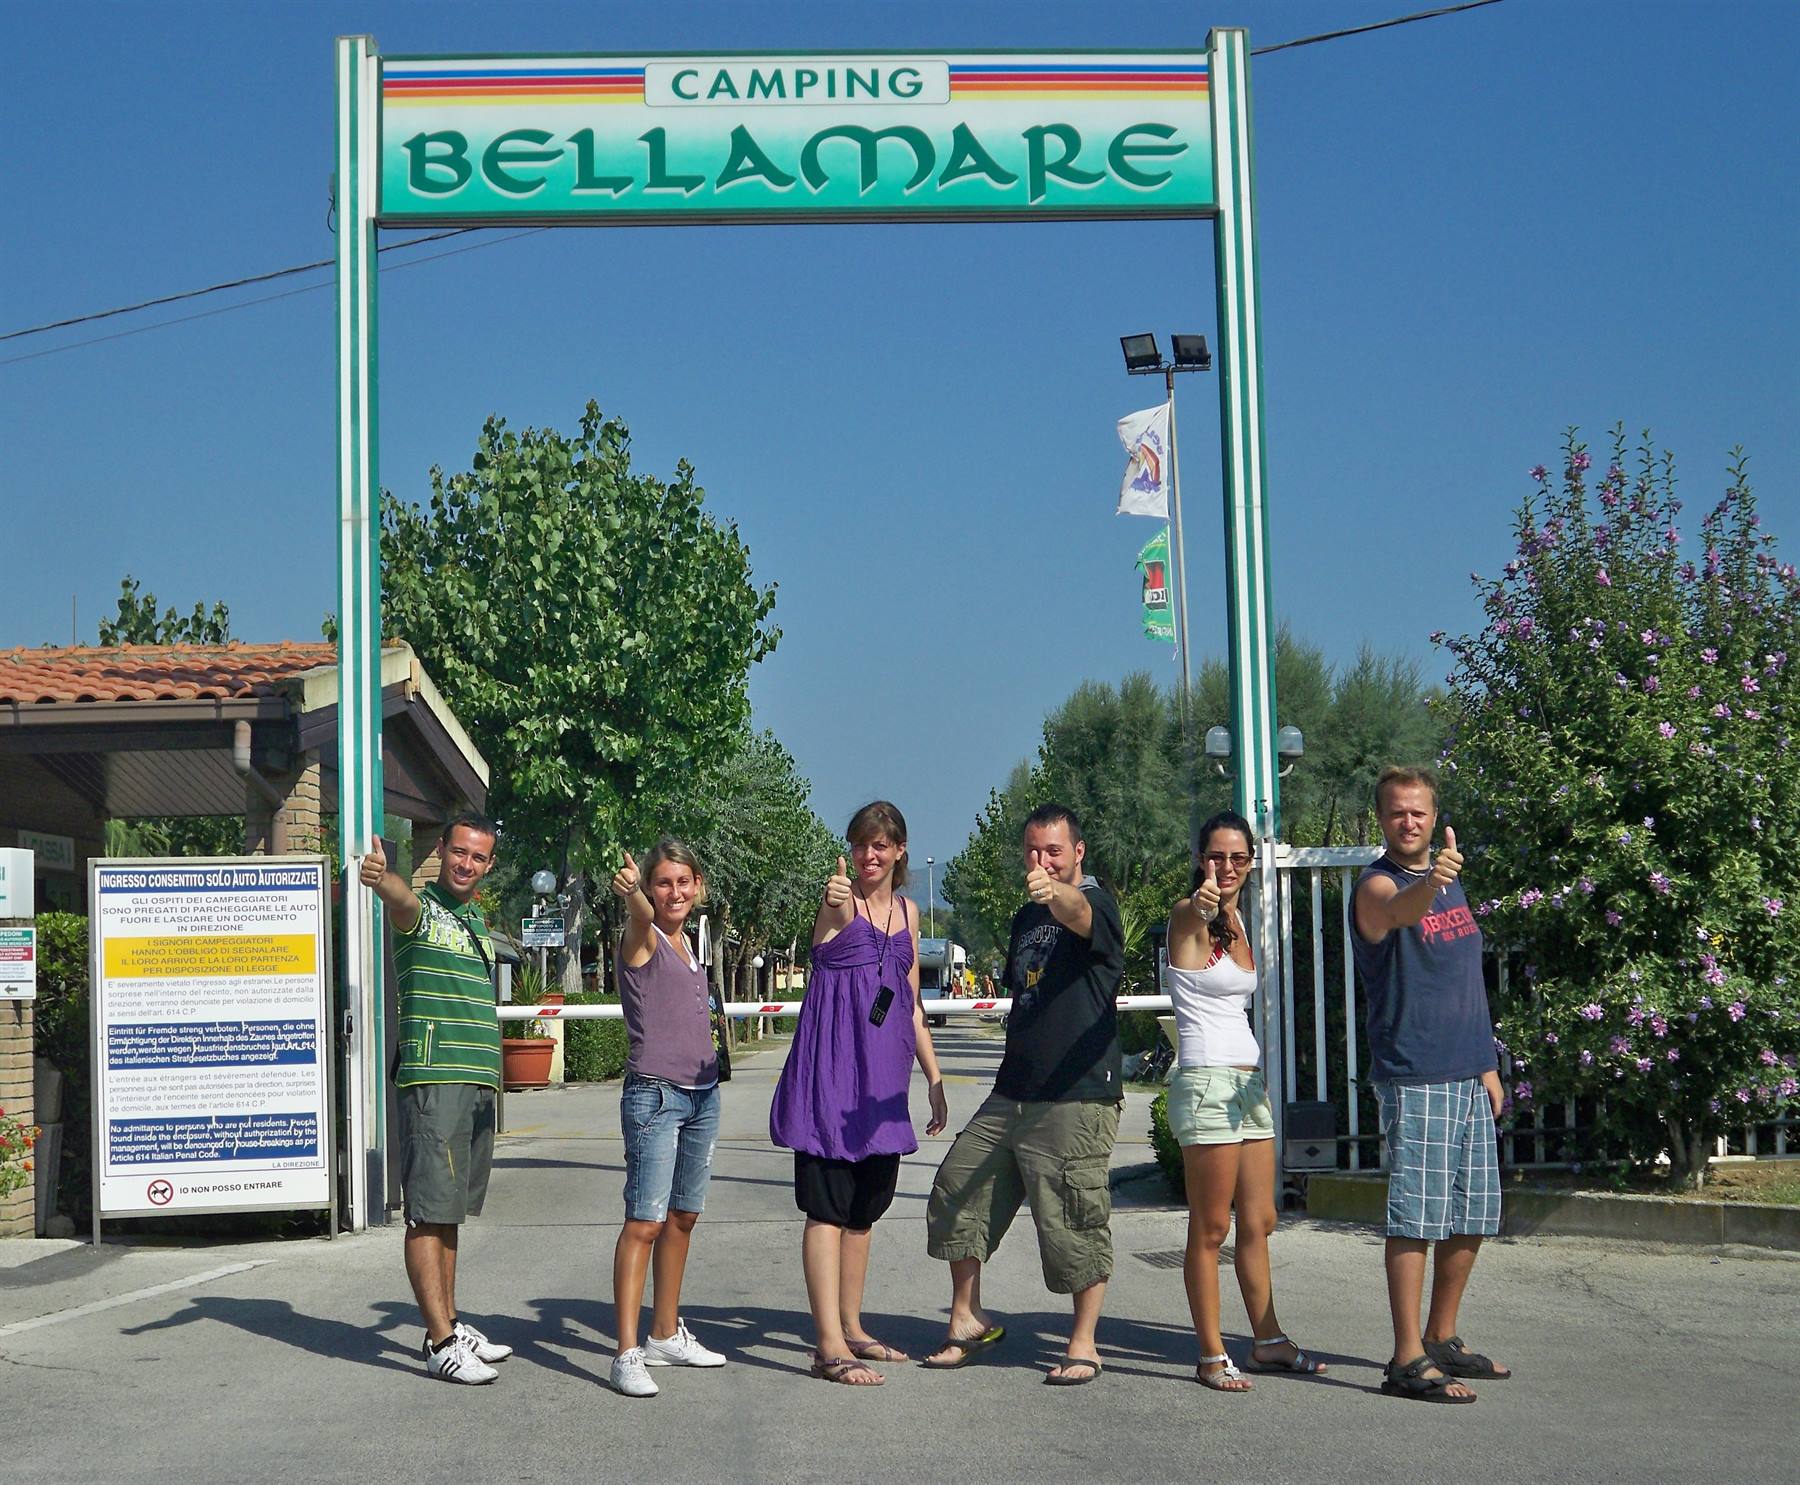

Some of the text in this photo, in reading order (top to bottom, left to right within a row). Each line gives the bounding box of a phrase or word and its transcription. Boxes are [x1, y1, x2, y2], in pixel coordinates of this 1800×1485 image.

[671, 66, 925, 102] CAMPING
[402, 122, 1190, 205] BELLAMARE
[101, 872, 316, 888] INGRESSO CONSENTITO SOLO AUTO AUTORIZZATE
[109, 1027, 134, 1035] Eintritt
[135, 1027, 146, 1035] für
[148, 1026, 177, 1034] Fremde
[179, 1025, 203, 1034] streng
[171, 1035, 201, 1043] Direktion
[124, 1056, 170, 1064] italienischen
[244, 1130, 291, 1138] authorization
[294, 1129, 303, 1138] by
[184, 1140, 223, 1149] denounced
[305, 1138, 316, 1147] per
[213, 1184, 241, 1192] POSSO
[244, 1181, 283, 1190] ENTRARE
